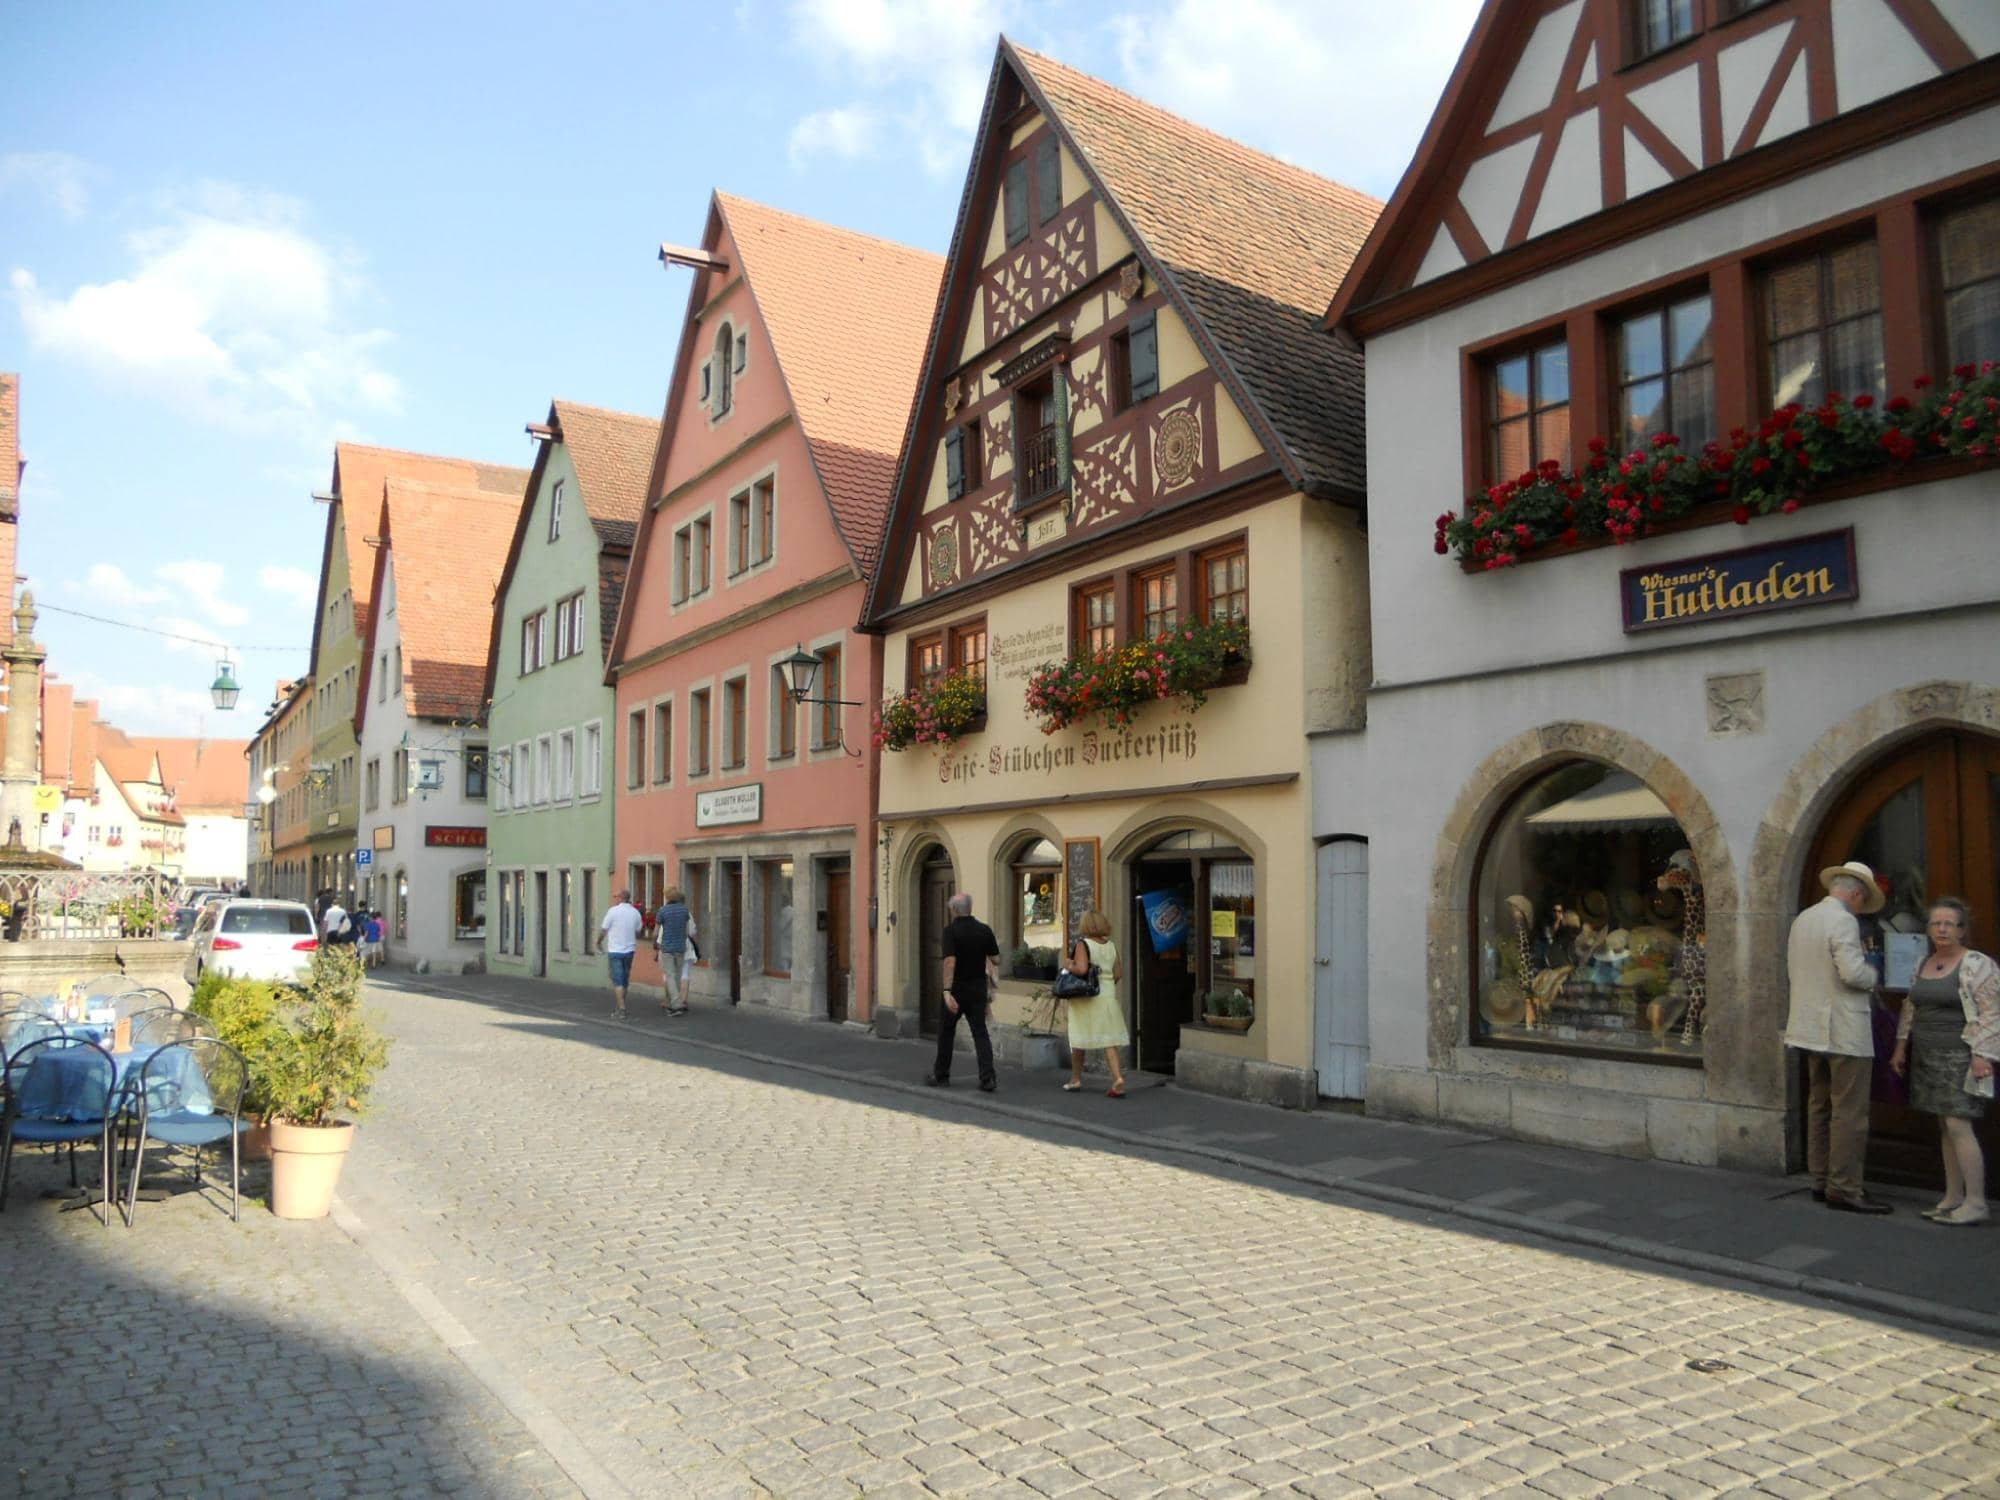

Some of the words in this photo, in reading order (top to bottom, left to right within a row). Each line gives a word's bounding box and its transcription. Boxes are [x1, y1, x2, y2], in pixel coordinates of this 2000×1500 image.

[1640, 566, 1717, 591] Wiesner's
[1642, 561, 1835, 623] Hutladen
[358, 850, 368, 863] P
